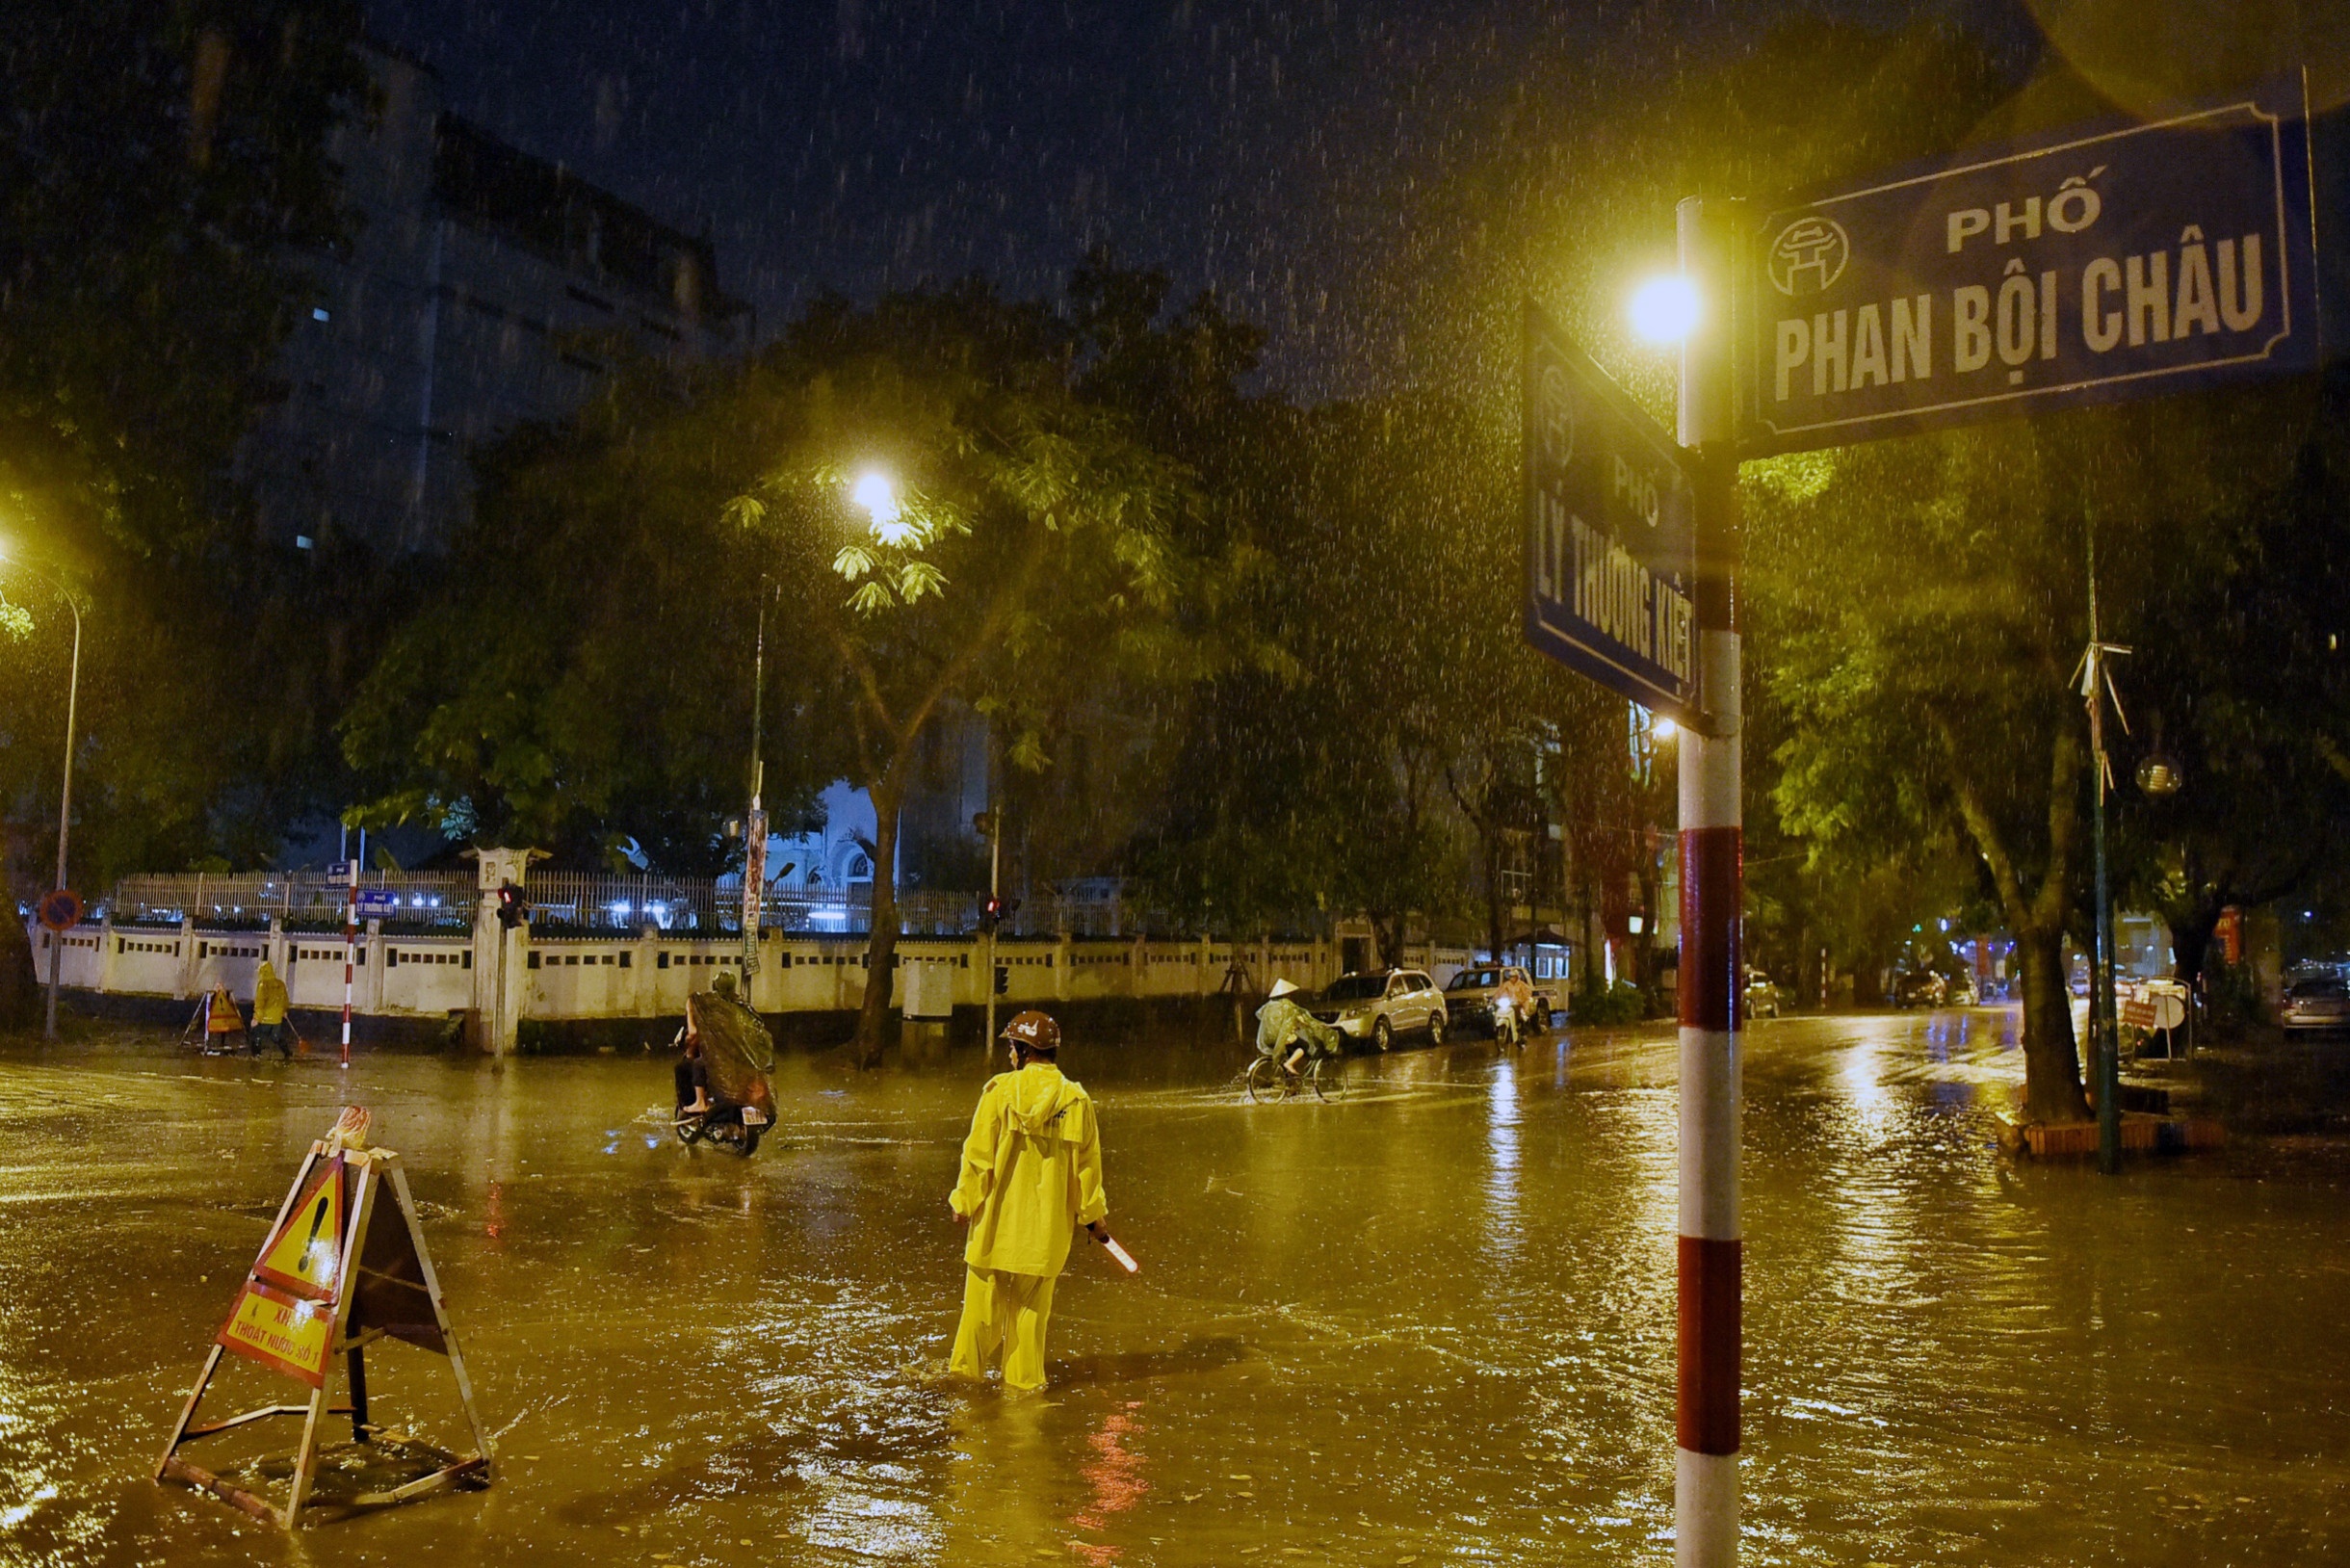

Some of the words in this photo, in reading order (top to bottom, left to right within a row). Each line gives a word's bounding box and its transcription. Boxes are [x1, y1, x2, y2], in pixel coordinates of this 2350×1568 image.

[1947, 165, 2107, 253] PHỐ
[1775, 293, 1932, 402] PHAN
[1954, 257, 2058, 384] BỘI
[2082, 223, 2264, 353] CHÂU
[1615, 454, 1659, 528] PHỐ
[1538, 478, 1565, 605] LÝ
[234, 1320, 267, 1344] THOÁT
[267, 1333, 295, 1356] NƯỚC
[312, 1351, 320, 1366] 1
